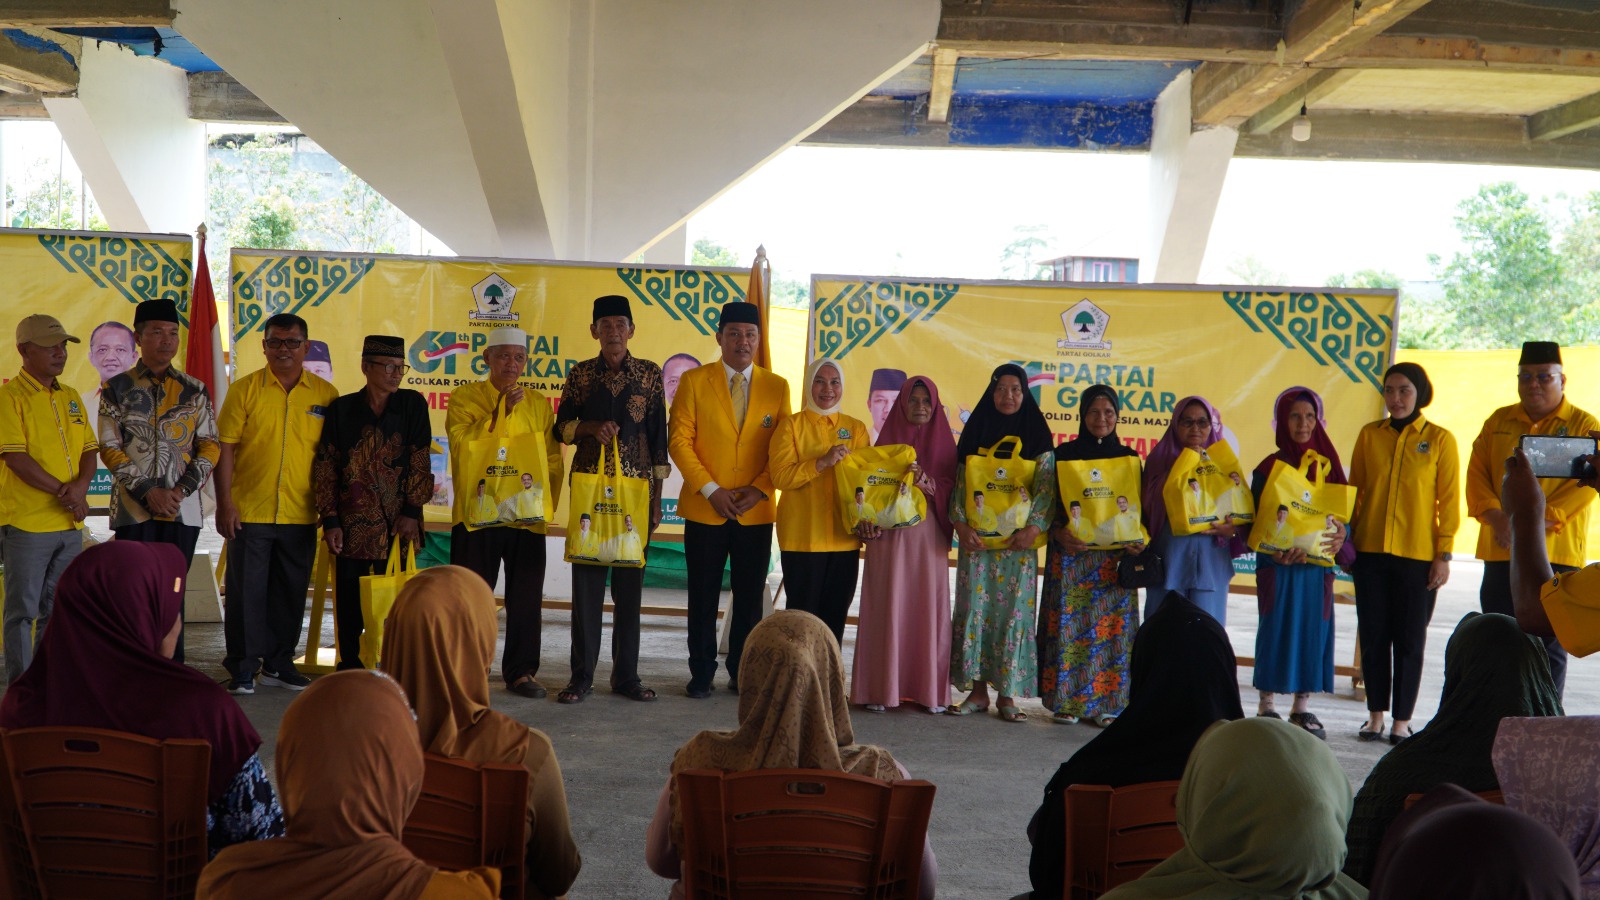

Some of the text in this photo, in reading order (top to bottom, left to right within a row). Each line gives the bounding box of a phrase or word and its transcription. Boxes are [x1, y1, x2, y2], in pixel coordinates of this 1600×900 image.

[472, 333, 558, 356] PTAI
[407, 377, 450, 386] GOLKAR
[1059, 363, 1154, 388] PARTAI
[1057, 387, 1176, 413] GKAR
[1043, 412, 1172, 426] OLID IESIA MAJ
